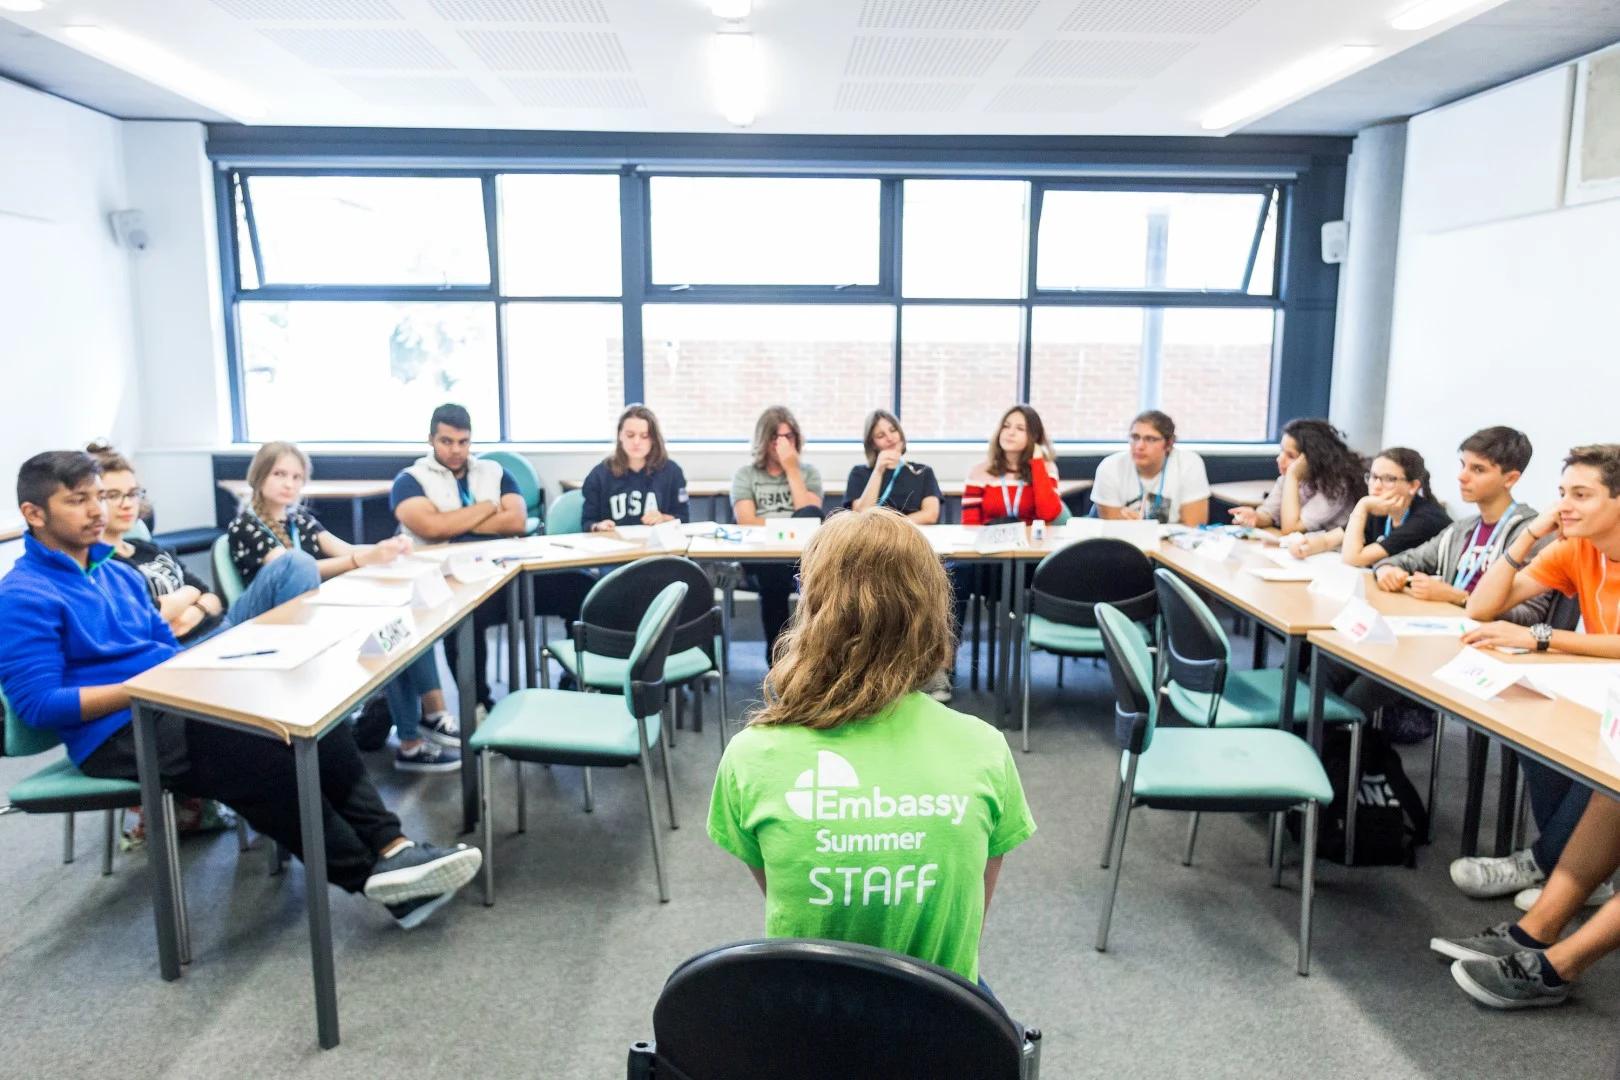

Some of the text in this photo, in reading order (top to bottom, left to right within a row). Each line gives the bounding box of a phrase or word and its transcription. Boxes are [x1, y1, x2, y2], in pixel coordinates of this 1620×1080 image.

[609, 490, 659, 520] USA
[816, 786, 968, 825] Embassy
[815, 829, 926, 852] Summer
[808, 863, 938, 906] STAFF
